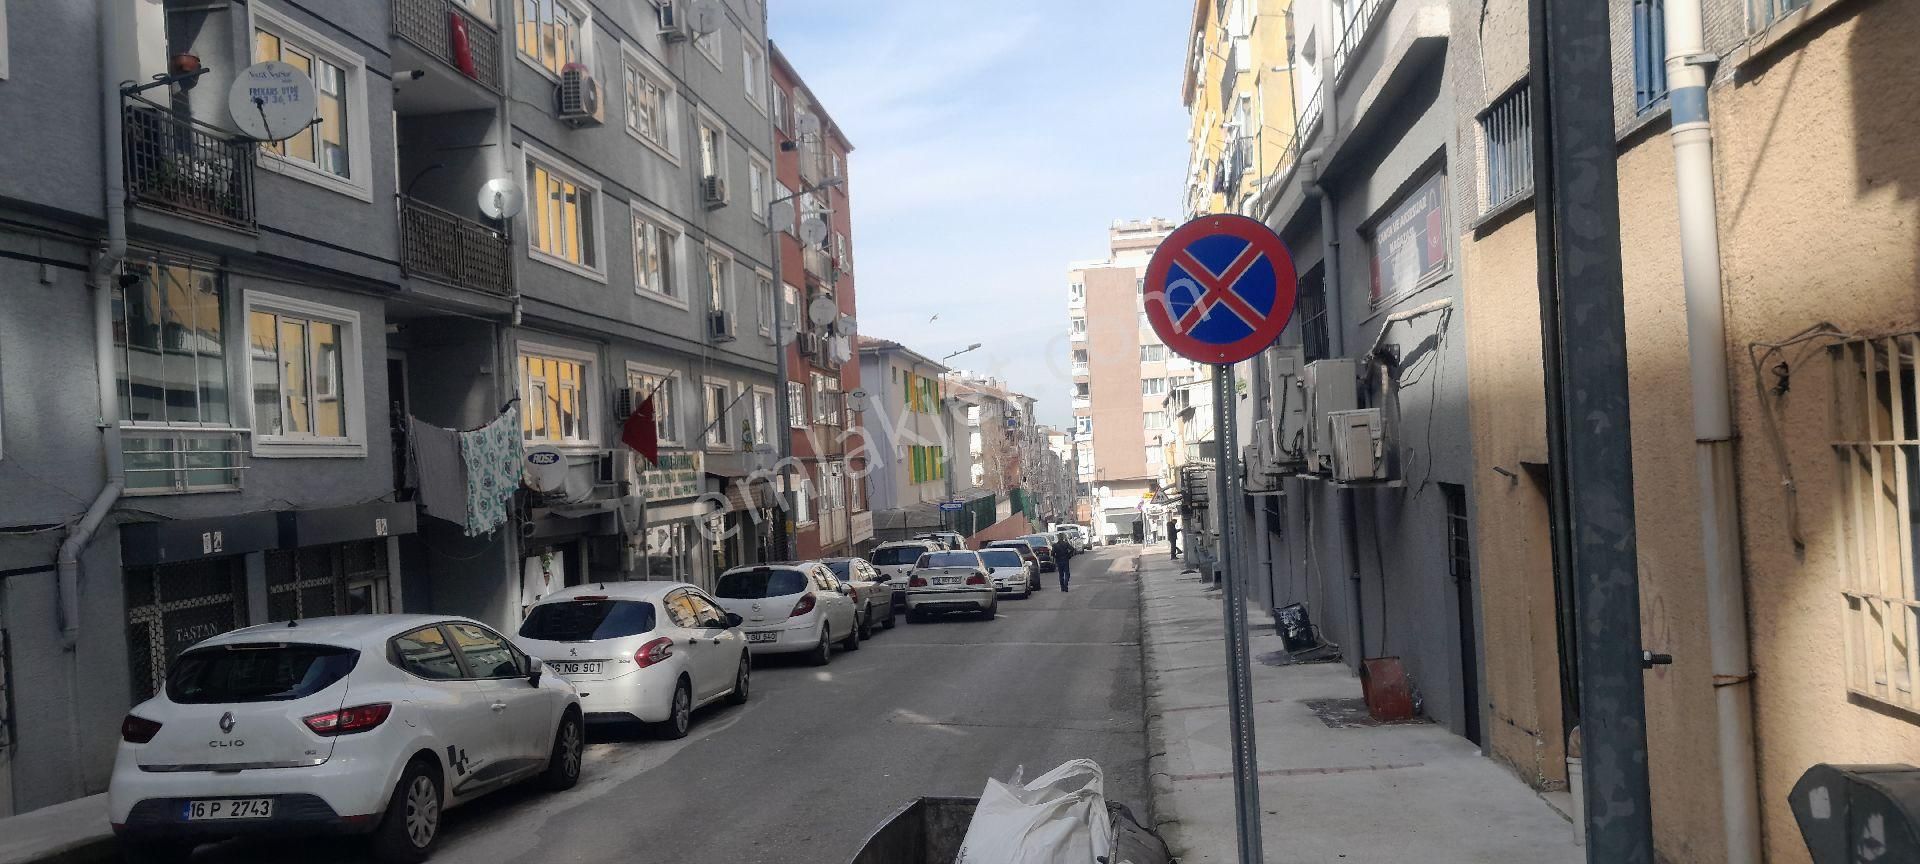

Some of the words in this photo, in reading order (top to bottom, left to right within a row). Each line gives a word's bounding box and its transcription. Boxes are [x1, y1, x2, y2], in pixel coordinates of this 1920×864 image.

[533, 454, 555, 464] ROSE
[564, 663, 578, 672] NG
[583, 663, 601, 672] 901
[209, 739, 245, 748] CLIO
[191, 802, 205, 817] 16
[210, 802, 221, 817] P
[231, 801, 270, 816] 2743
